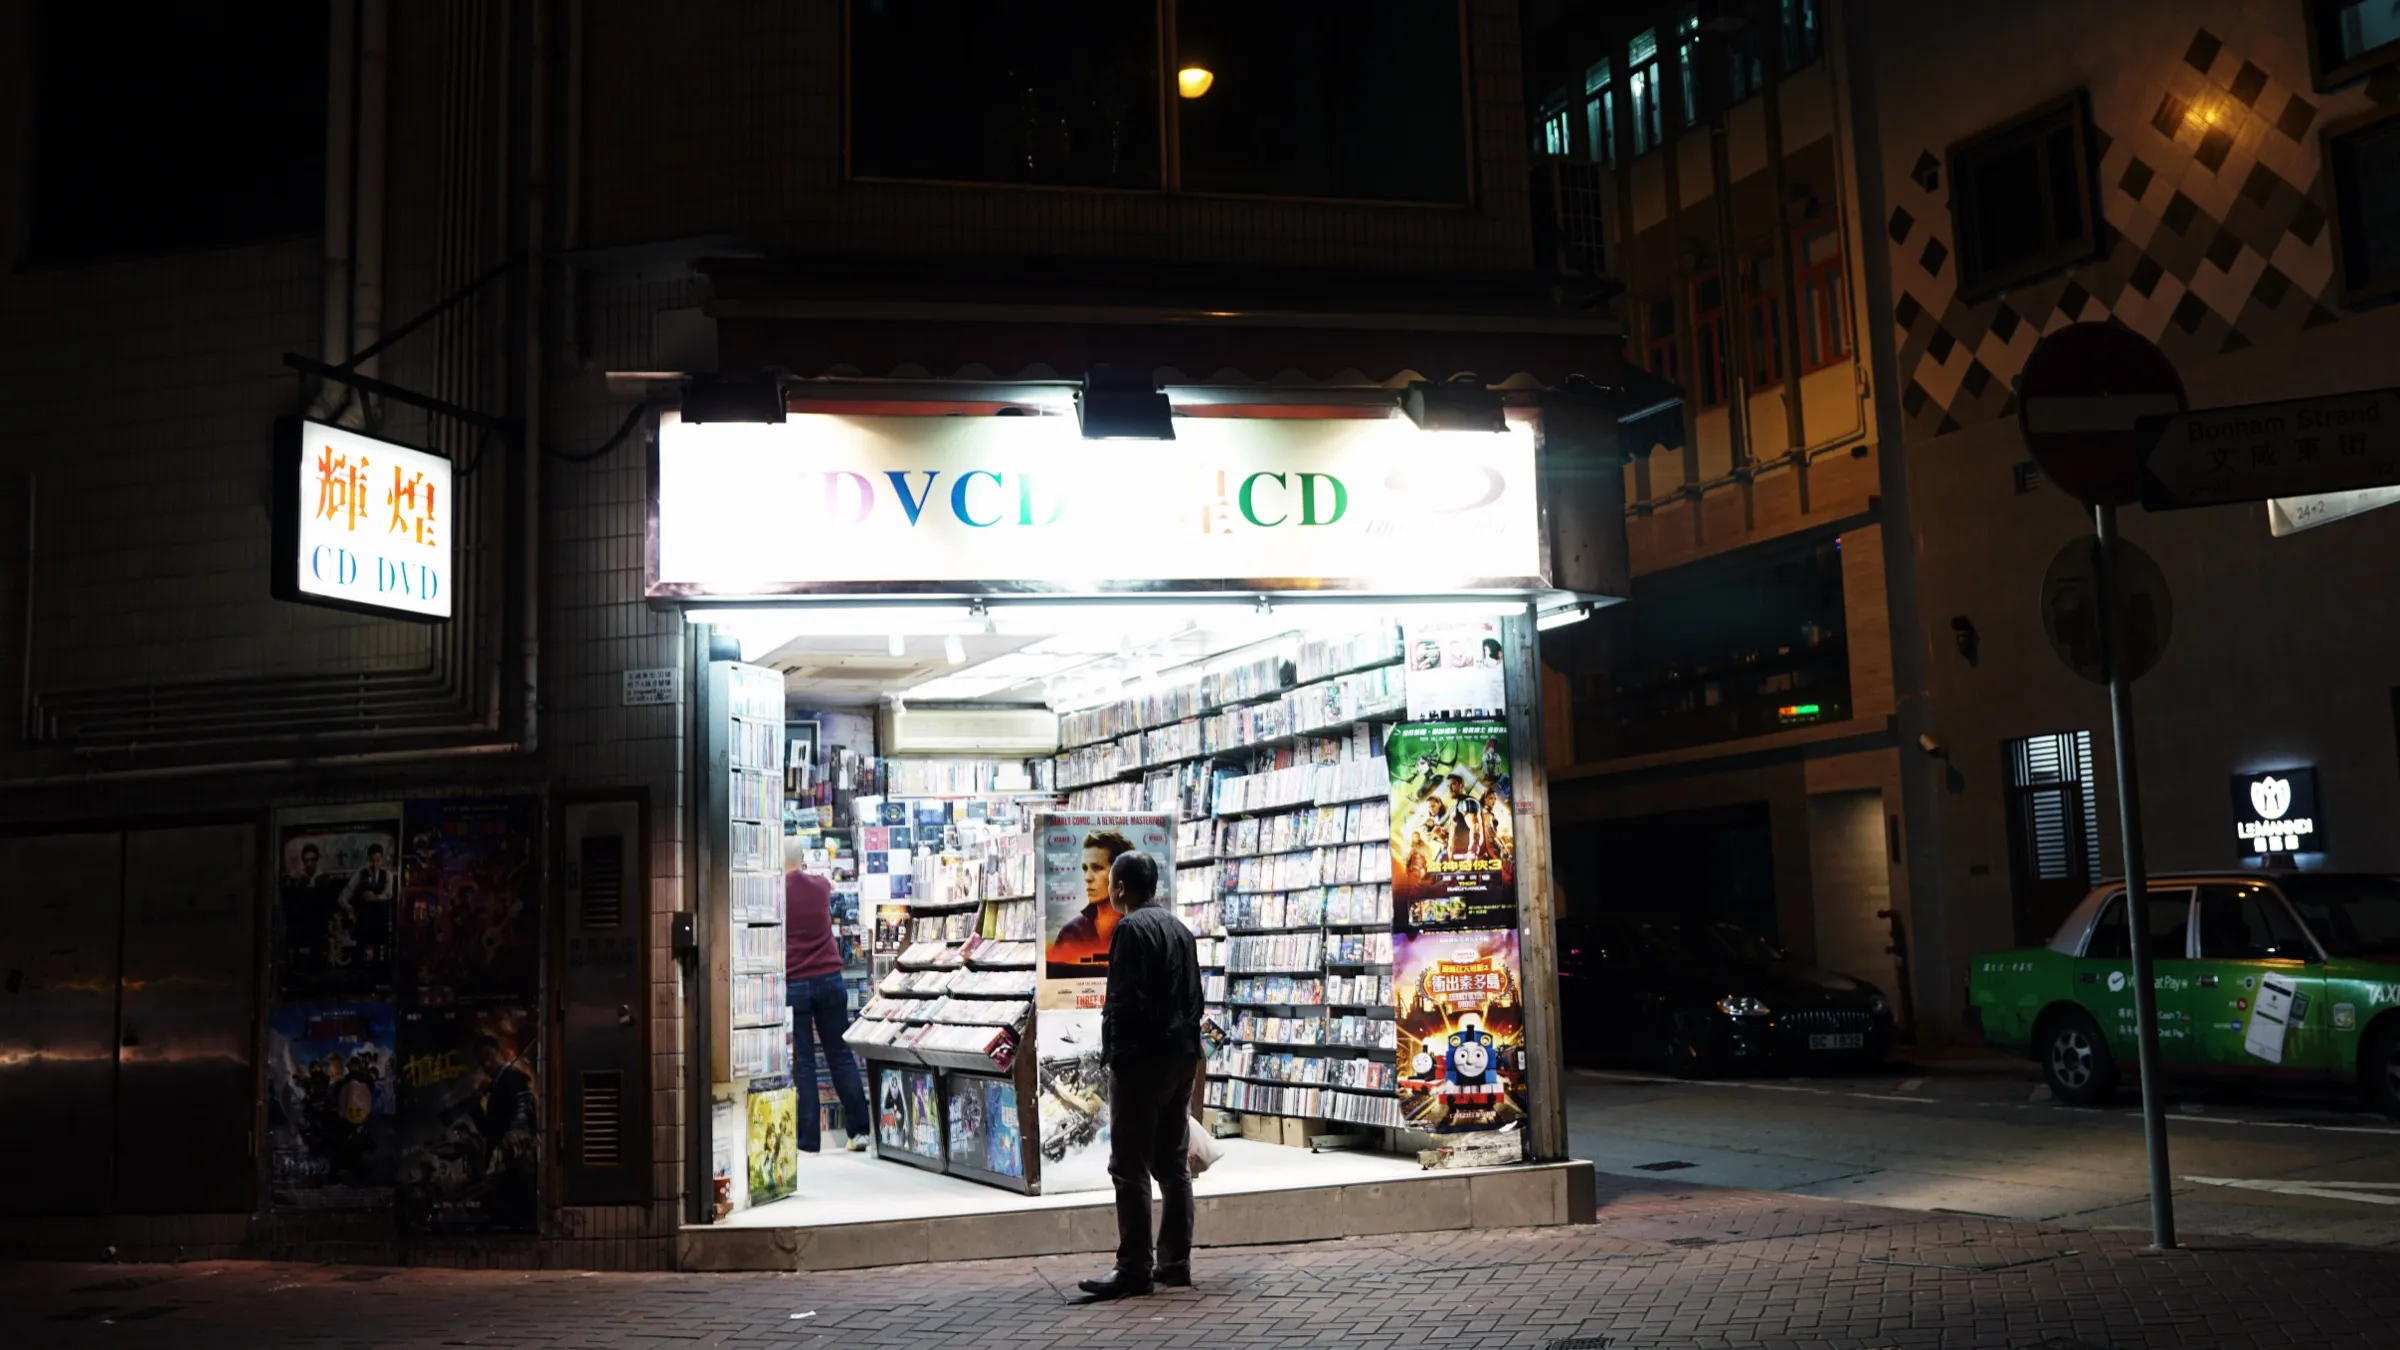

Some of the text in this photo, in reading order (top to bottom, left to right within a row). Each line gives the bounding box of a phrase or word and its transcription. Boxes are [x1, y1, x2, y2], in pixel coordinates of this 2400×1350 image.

[2188, 400, 2381, 441] Bonham Strand
[2206, 431, 2367, 473] 文咸東街
[315, 444, 437, 547] 輝煌
[1237, 470, 1349, 528] CD
[312, 544, 438, 601] CD DVD
[1076, 995, 1098, 1005] THREE
[1432, 973, 1501, 993] 衝出索多島
[2164, 974, 2181, 992] Pay
